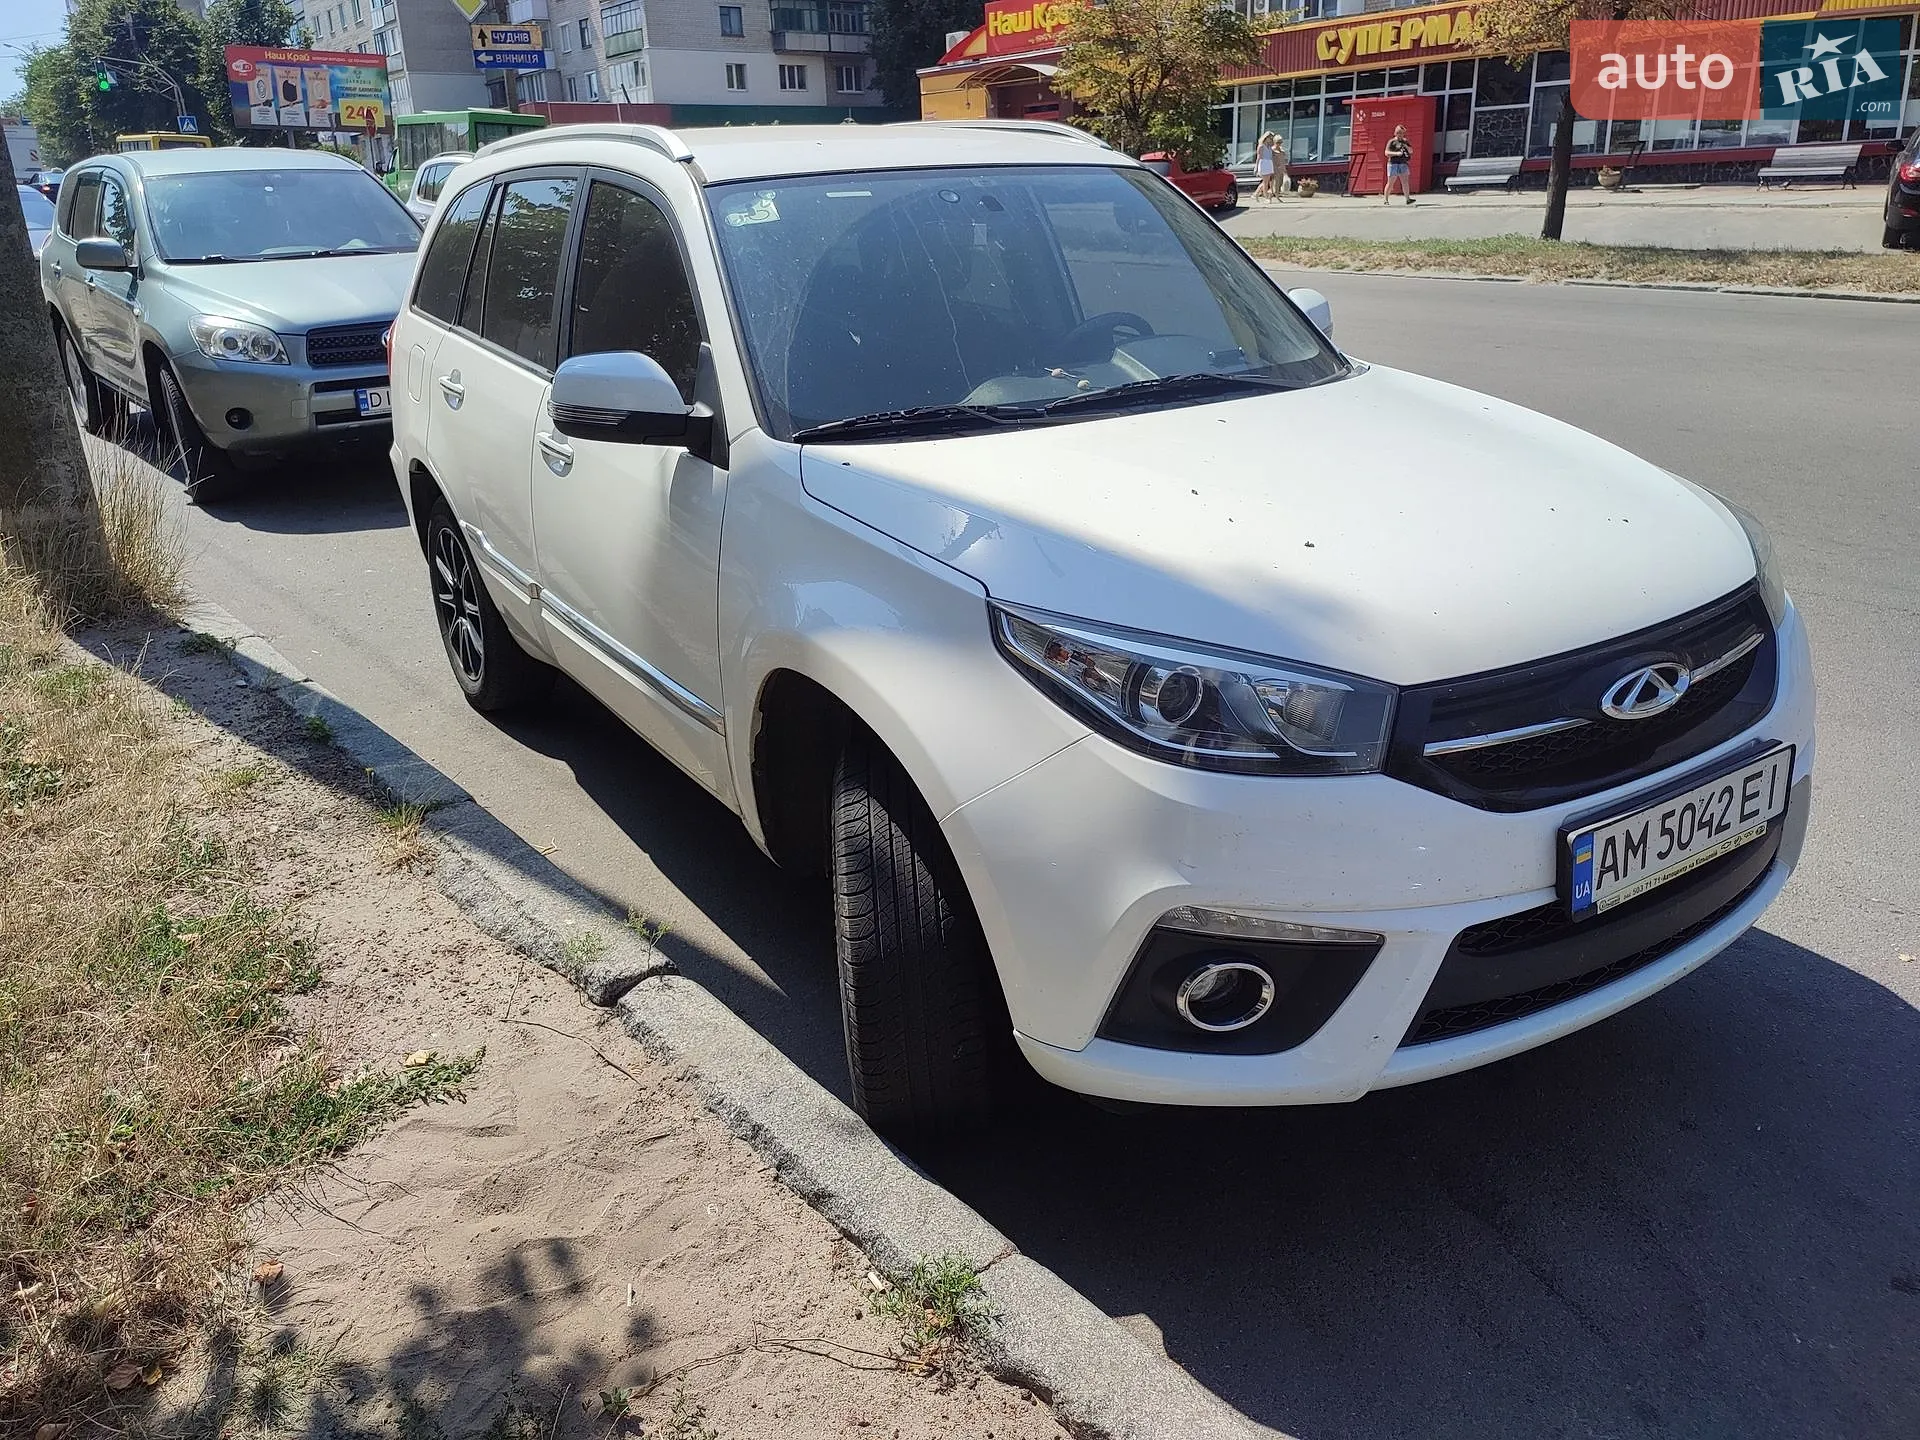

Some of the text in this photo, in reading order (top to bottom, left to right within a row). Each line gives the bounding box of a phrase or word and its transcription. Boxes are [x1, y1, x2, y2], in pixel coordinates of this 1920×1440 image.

[988, 2, 1072, 37] Наш Кра
[493, 32, 530, 43] ЧУДНІВ
[264, 51, 287, 61] Наш
[287, 51, 310, 63] Край
[495, 53, 539, 65] ВІННИЦЯ
[1596, 763, 1778, 891] AM 5042 EI
[1575, 881, 1591, 899] UA
